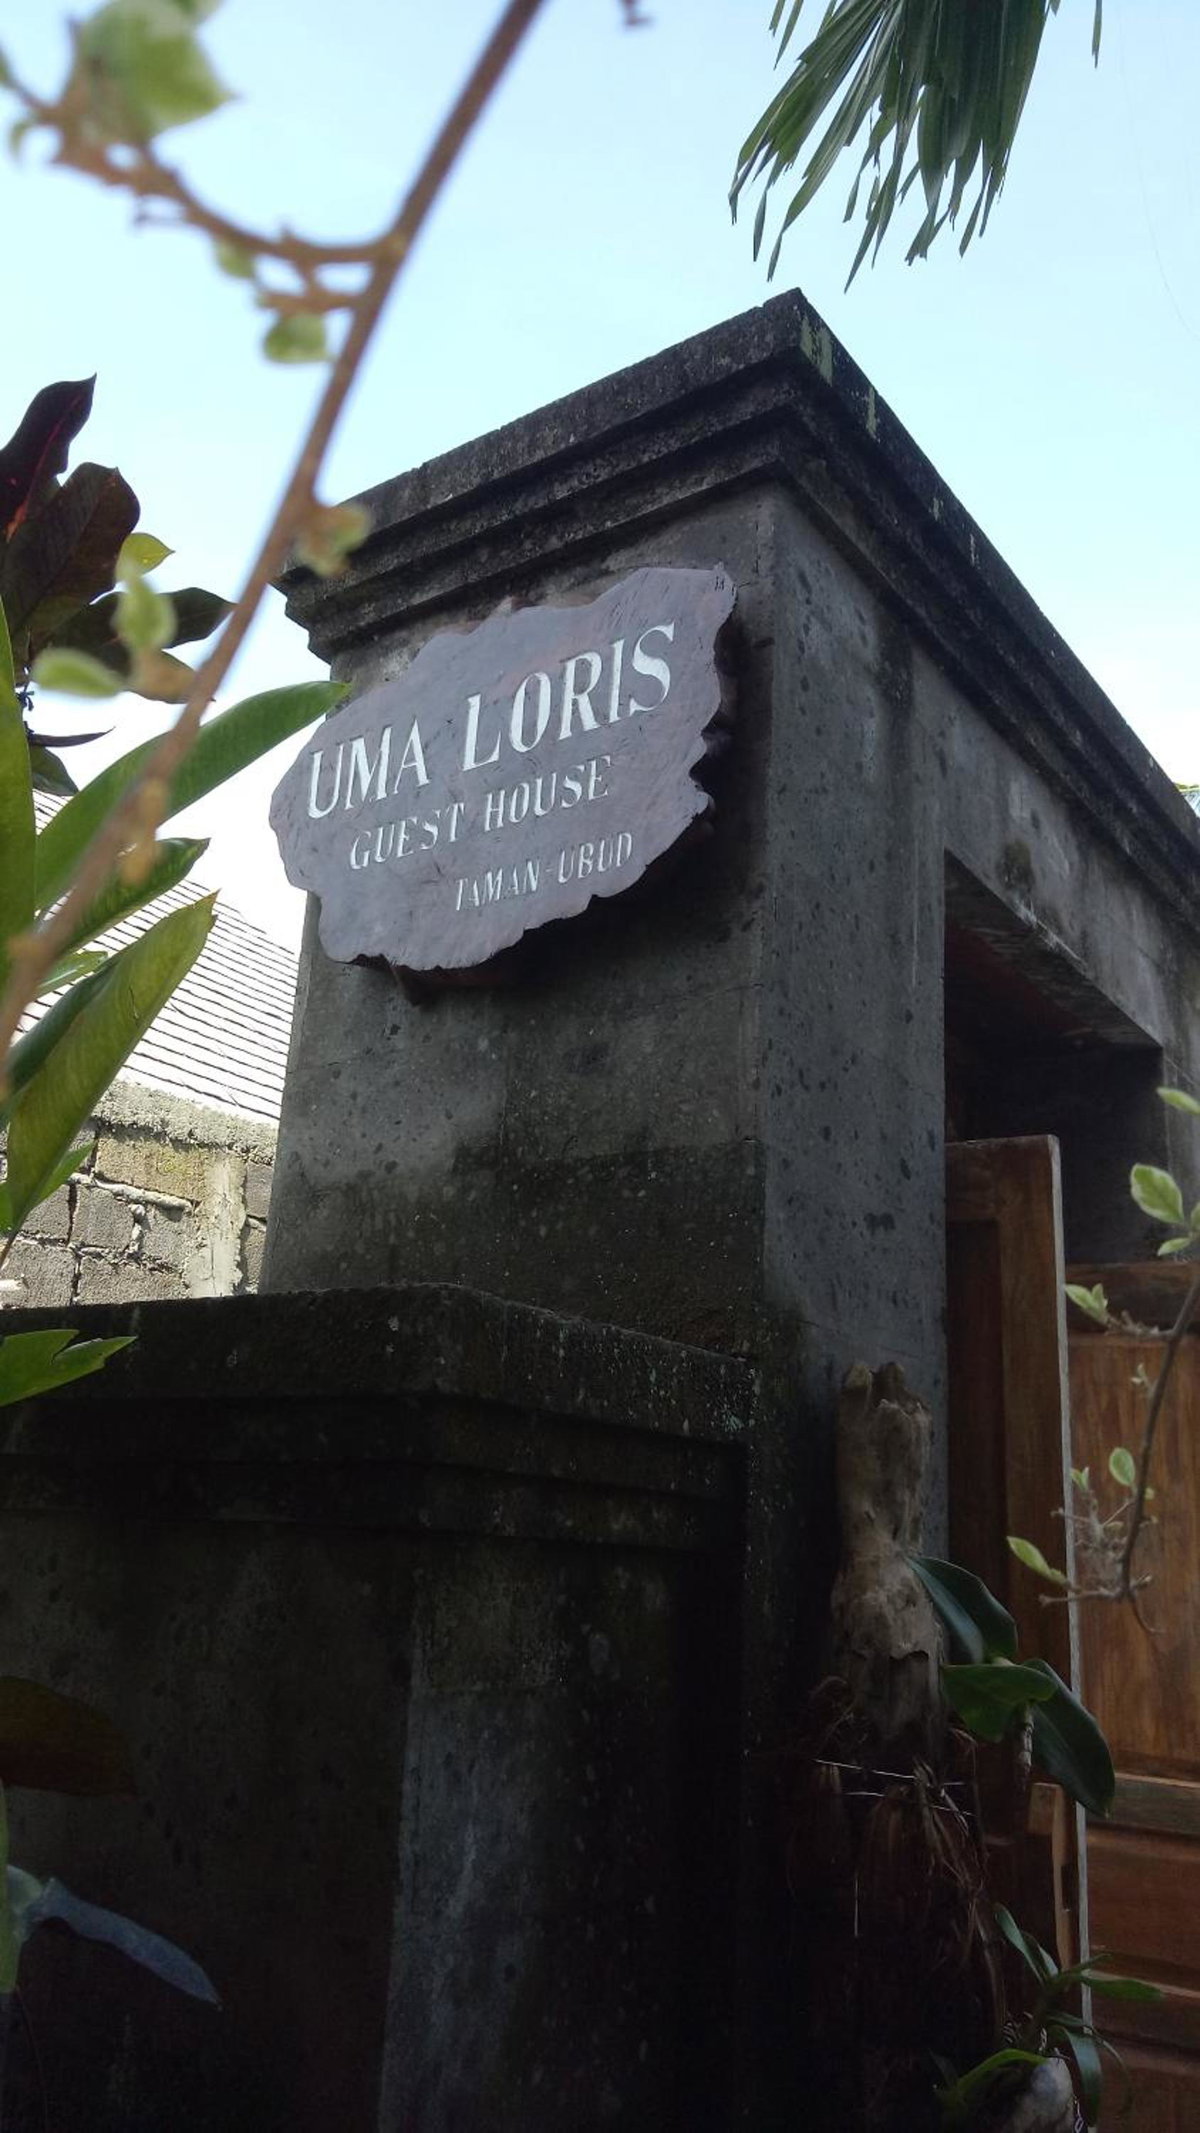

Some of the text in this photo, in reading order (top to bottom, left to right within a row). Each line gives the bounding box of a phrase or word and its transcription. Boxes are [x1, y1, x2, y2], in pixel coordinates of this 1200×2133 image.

[307, 621, 675, 819] UMA LORIS
[350, 755, 613, 870] GUEST HOUSE
